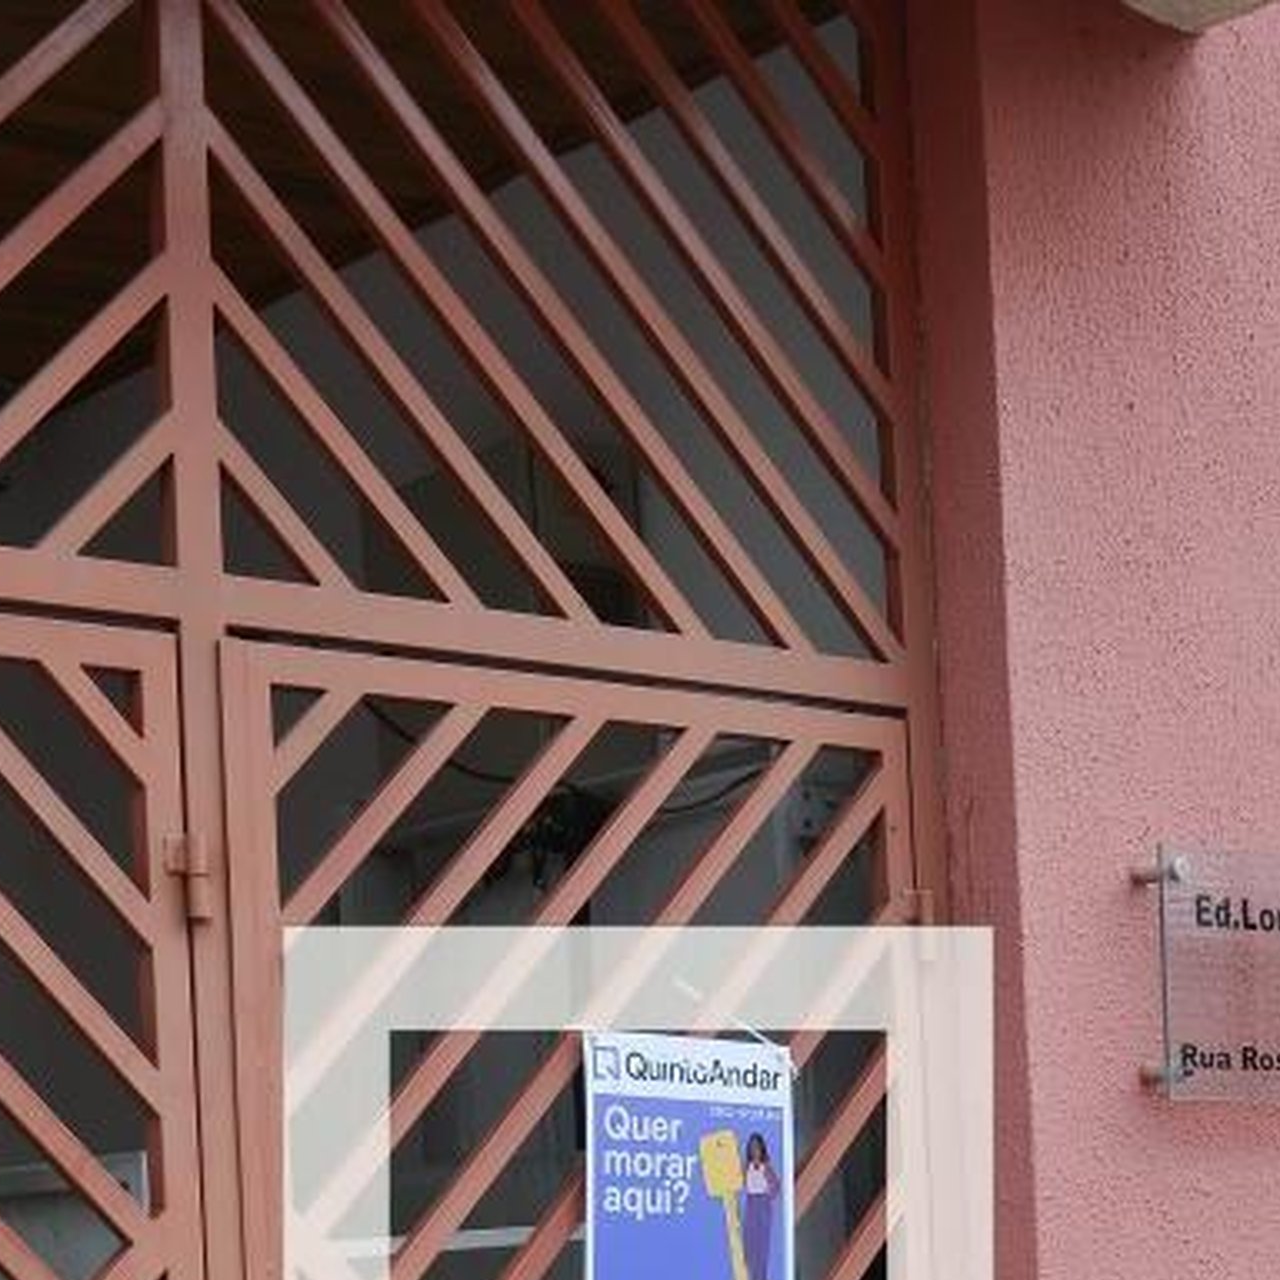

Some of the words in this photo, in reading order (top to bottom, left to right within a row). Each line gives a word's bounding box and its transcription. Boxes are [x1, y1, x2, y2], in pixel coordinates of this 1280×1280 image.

[625, 1052, 782, 1091] QuintoAndar
[1180, 1044, 1232, 1071] Rua
[605, 1105, 683, 1142] Quer
[604, 1150, 697, 1179] morar
[603, 1181, 690, 1221] aqui?
